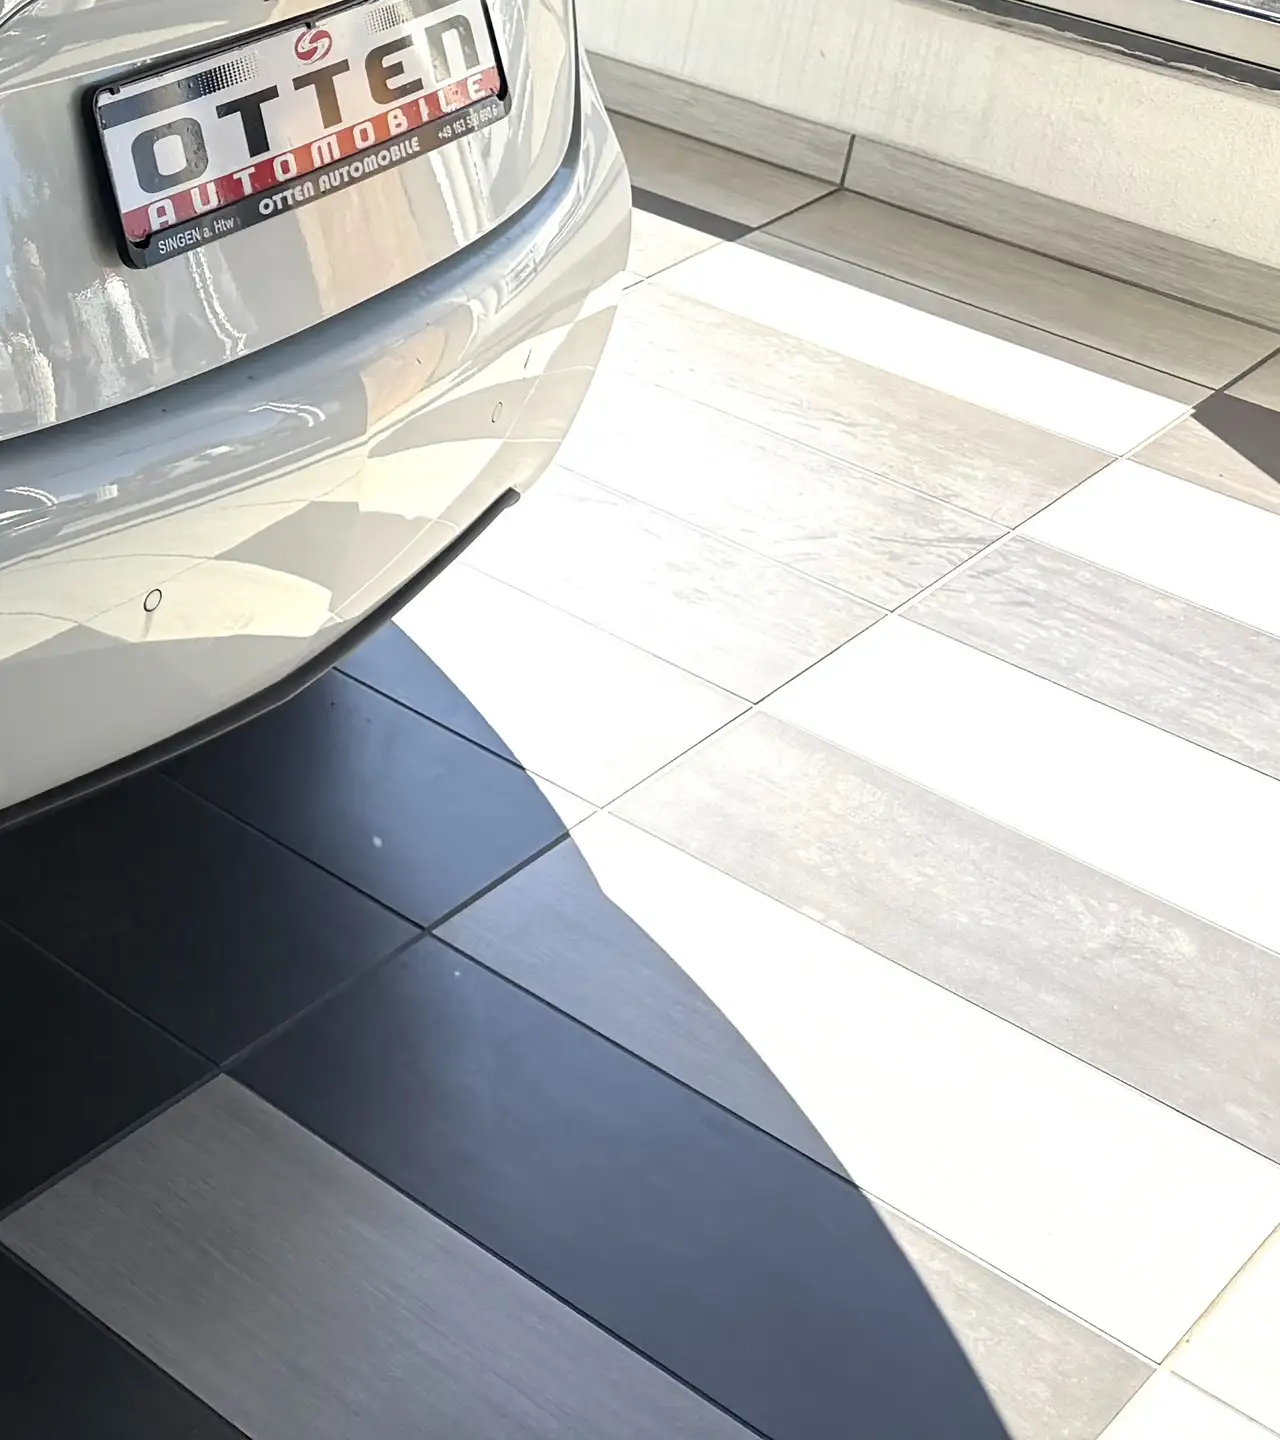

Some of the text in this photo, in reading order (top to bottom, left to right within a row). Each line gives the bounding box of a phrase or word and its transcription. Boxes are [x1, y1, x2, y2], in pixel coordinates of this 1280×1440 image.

[131, 15, 480, 193] OTTEN
[147, 73, 486, 231] AUTOMOBILE
[158, 226, 201, 255] SINGEN
[258, 181, 314, 216] OTTEN
[319, 136, 420, 193] AUTOMOBILE
